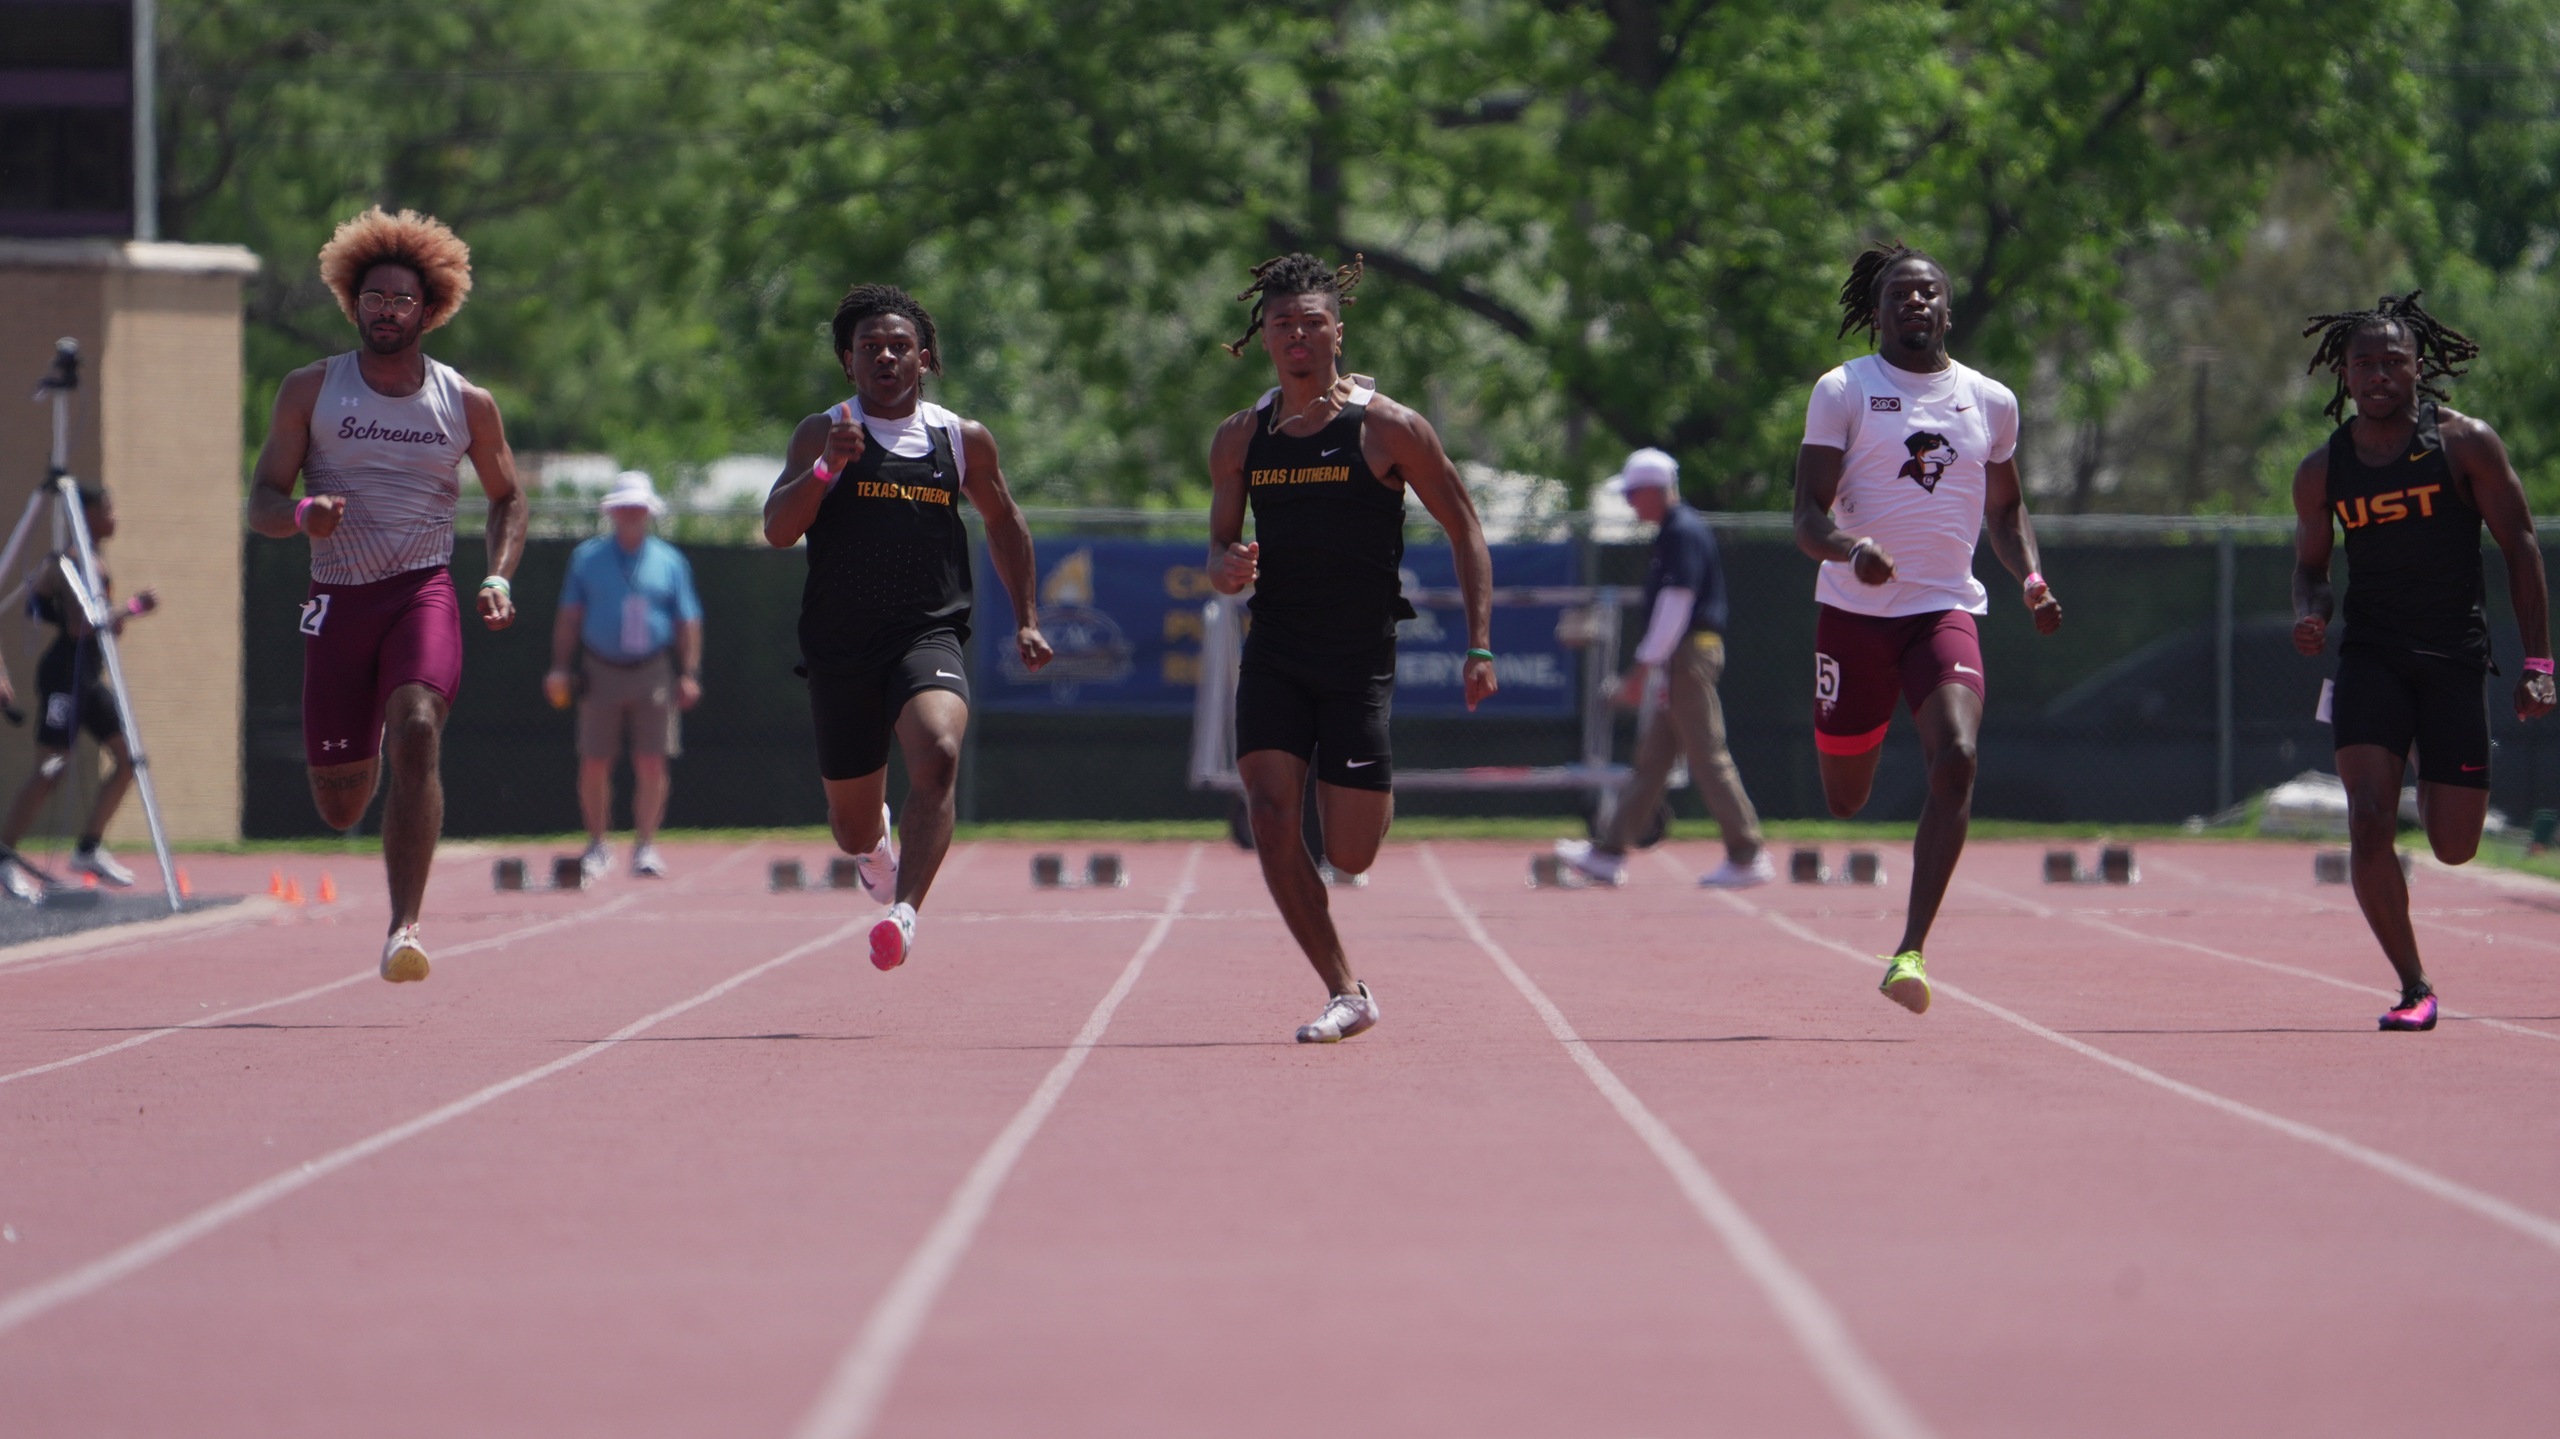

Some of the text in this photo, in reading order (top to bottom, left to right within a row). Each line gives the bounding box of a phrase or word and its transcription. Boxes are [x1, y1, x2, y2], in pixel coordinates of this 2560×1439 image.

[338, 416, 447, 445] Schreiner
[857, 481, 899, 498] TEXAS
[1251, 466, 1350, 486] TEXAS LUTHERAN
[2336, 483, 2441, 529] UST
[301, 597, 322, 631] 2
[1819, 656, 1835, 696] 5
